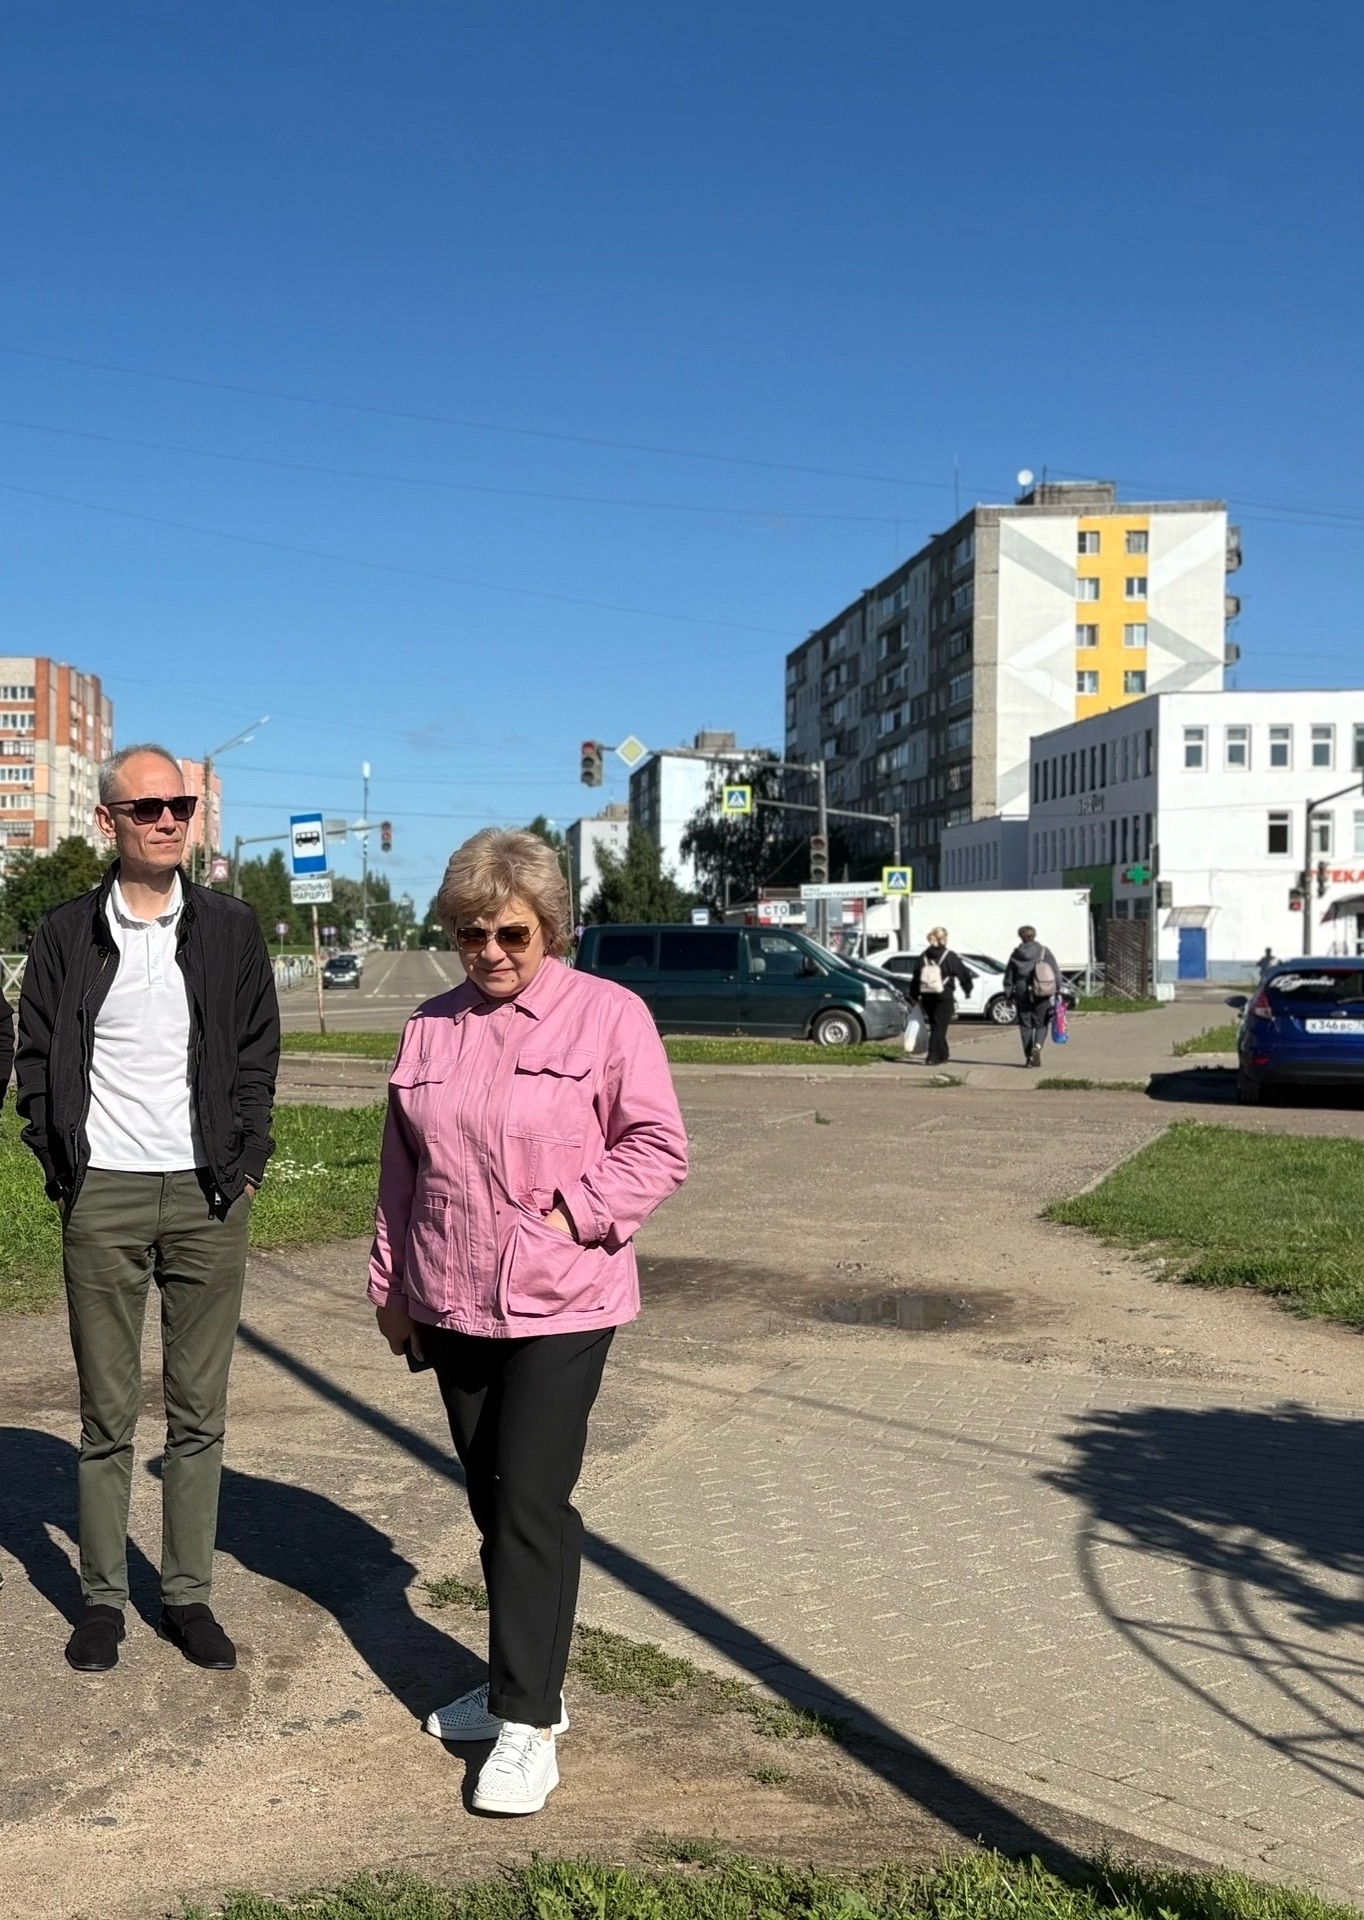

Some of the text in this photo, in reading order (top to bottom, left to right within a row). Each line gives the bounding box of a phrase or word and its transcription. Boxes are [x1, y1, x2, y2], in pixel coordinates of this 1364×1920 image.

[292, 881, 331, 892] ШКОЛЬНЫЙ
[292, 891, 331, 900] МАРШРУТ
[764, 905, 788, 915] СТО
